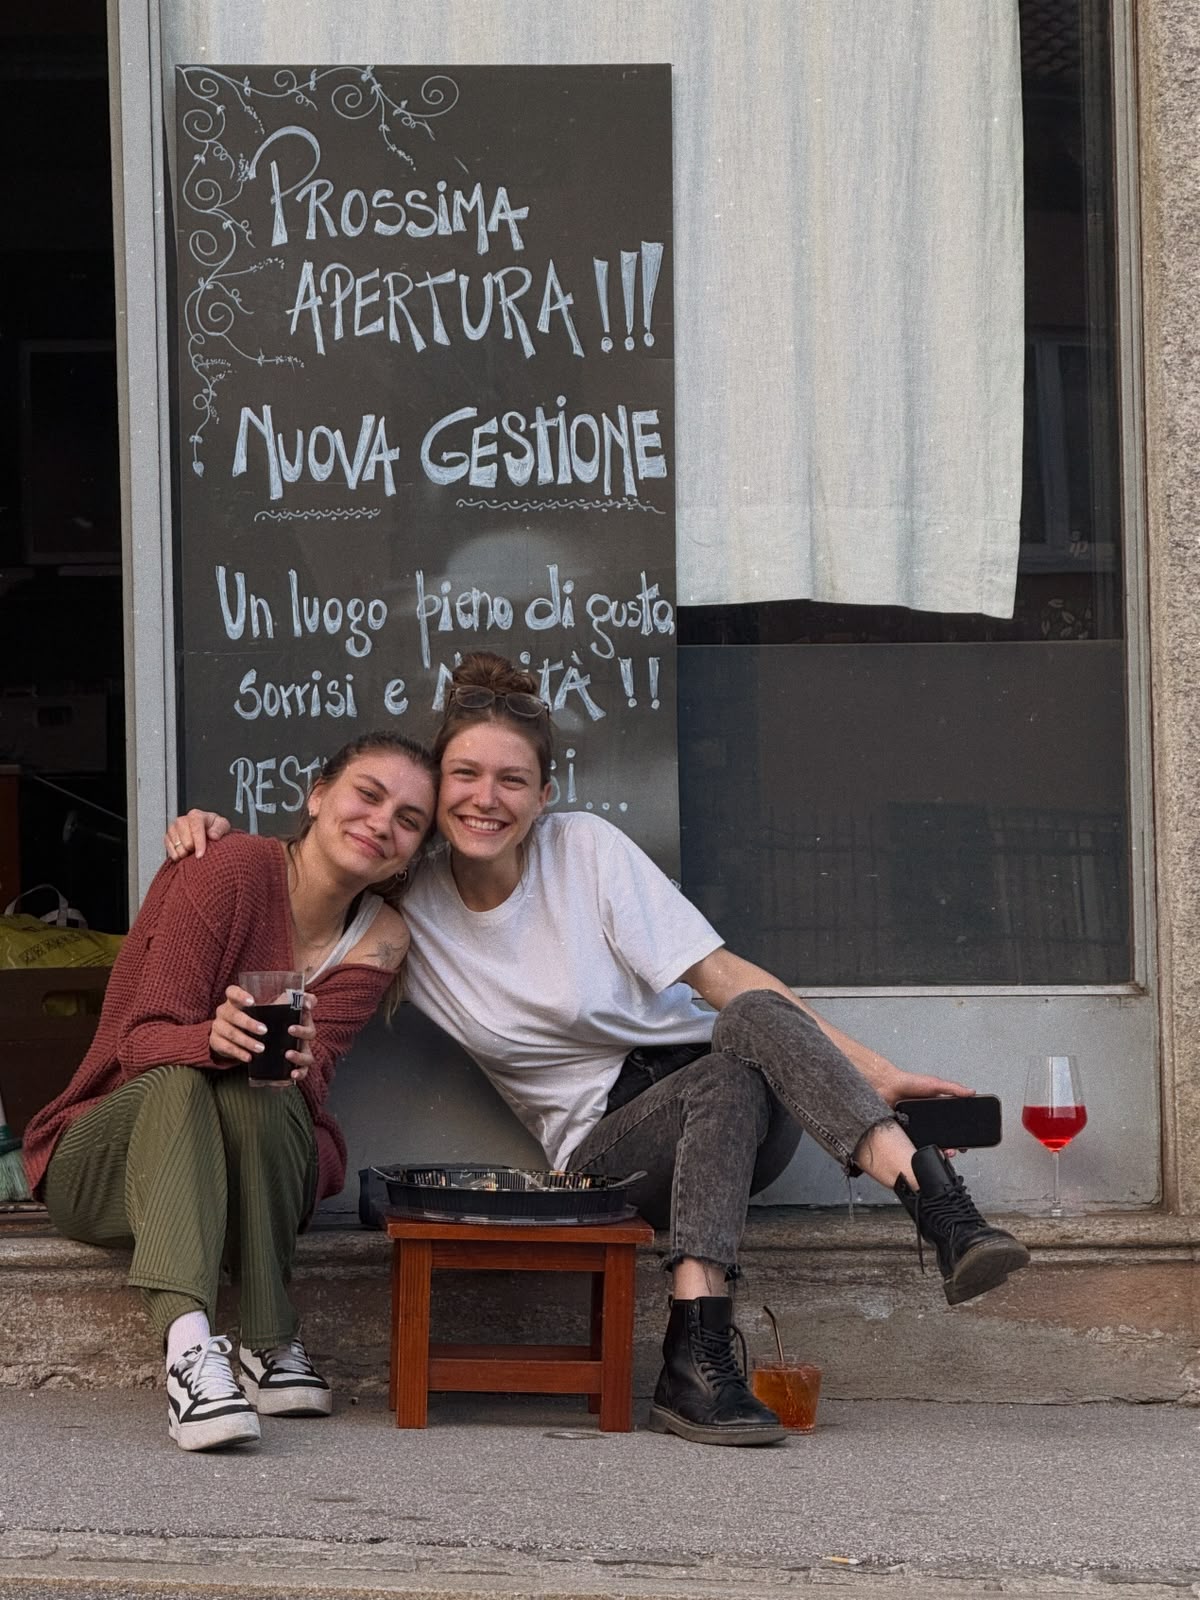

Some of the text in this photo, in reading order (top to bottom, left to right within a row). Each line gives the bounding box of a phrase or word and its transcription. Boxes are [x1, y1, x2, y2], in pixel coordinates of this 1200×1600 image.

[285, 258, 585, 358] APERTURA
[215, 564, 274, 640] Un
[288, 568, 388, 658] luogo
[415, 569, 514, 669] pieno
[525, 563, 576, 631] di
[384, 679, 409, 715] e
